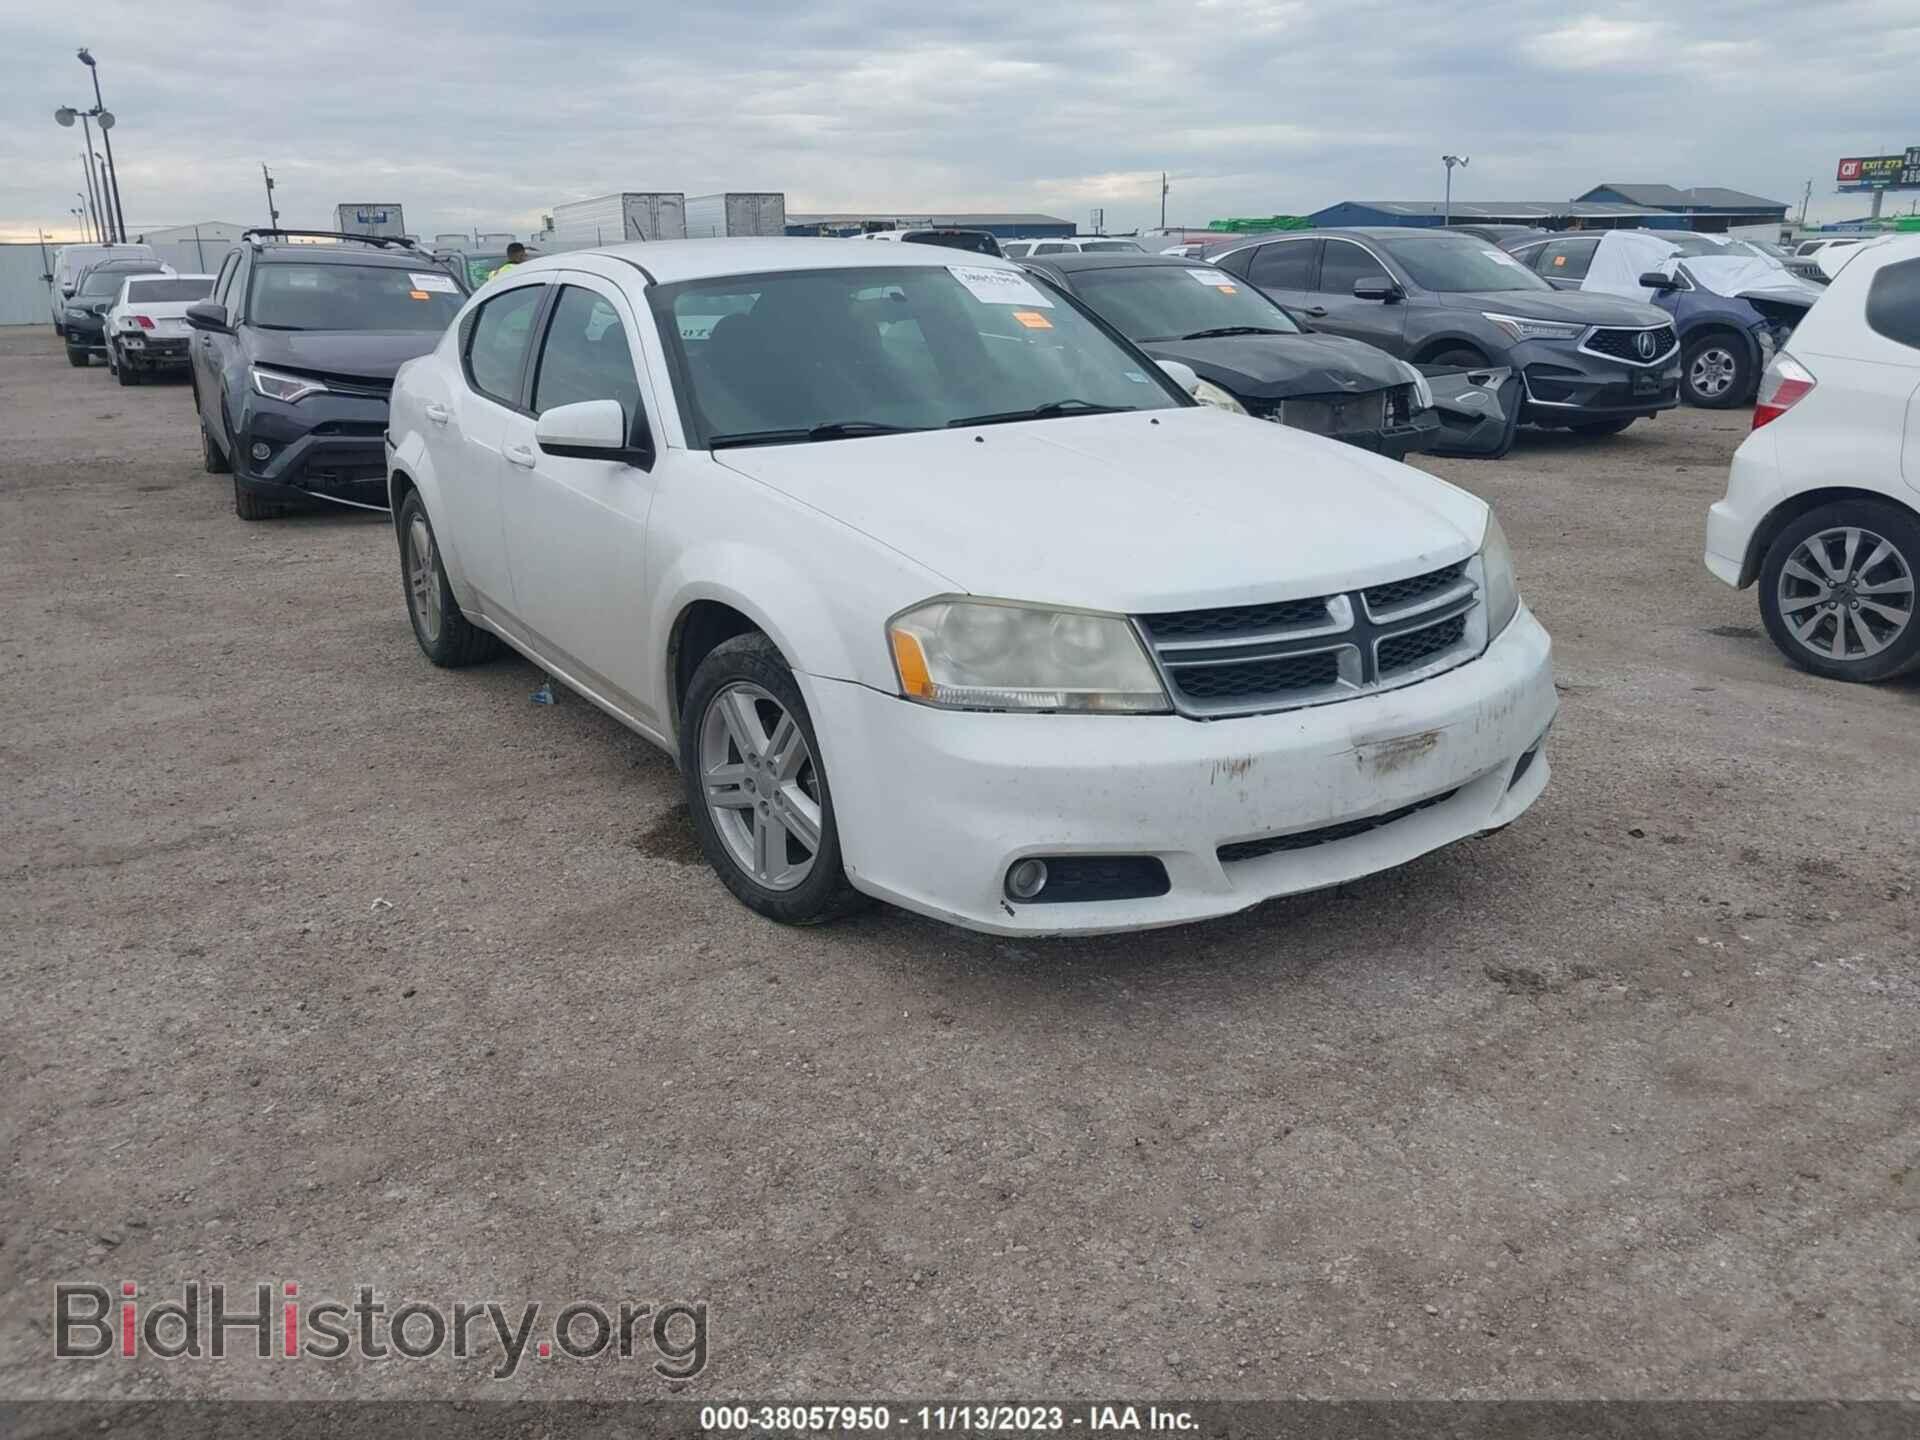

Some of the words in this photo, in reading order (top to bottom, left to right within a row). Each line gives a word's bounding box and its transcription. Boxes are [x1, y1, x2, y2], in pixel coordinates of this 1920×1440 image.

[1841, 162, 1858, 176] QT
[1862, 160, 1883, 170] EXIT
[1884, 159, 1903, 168] 273
